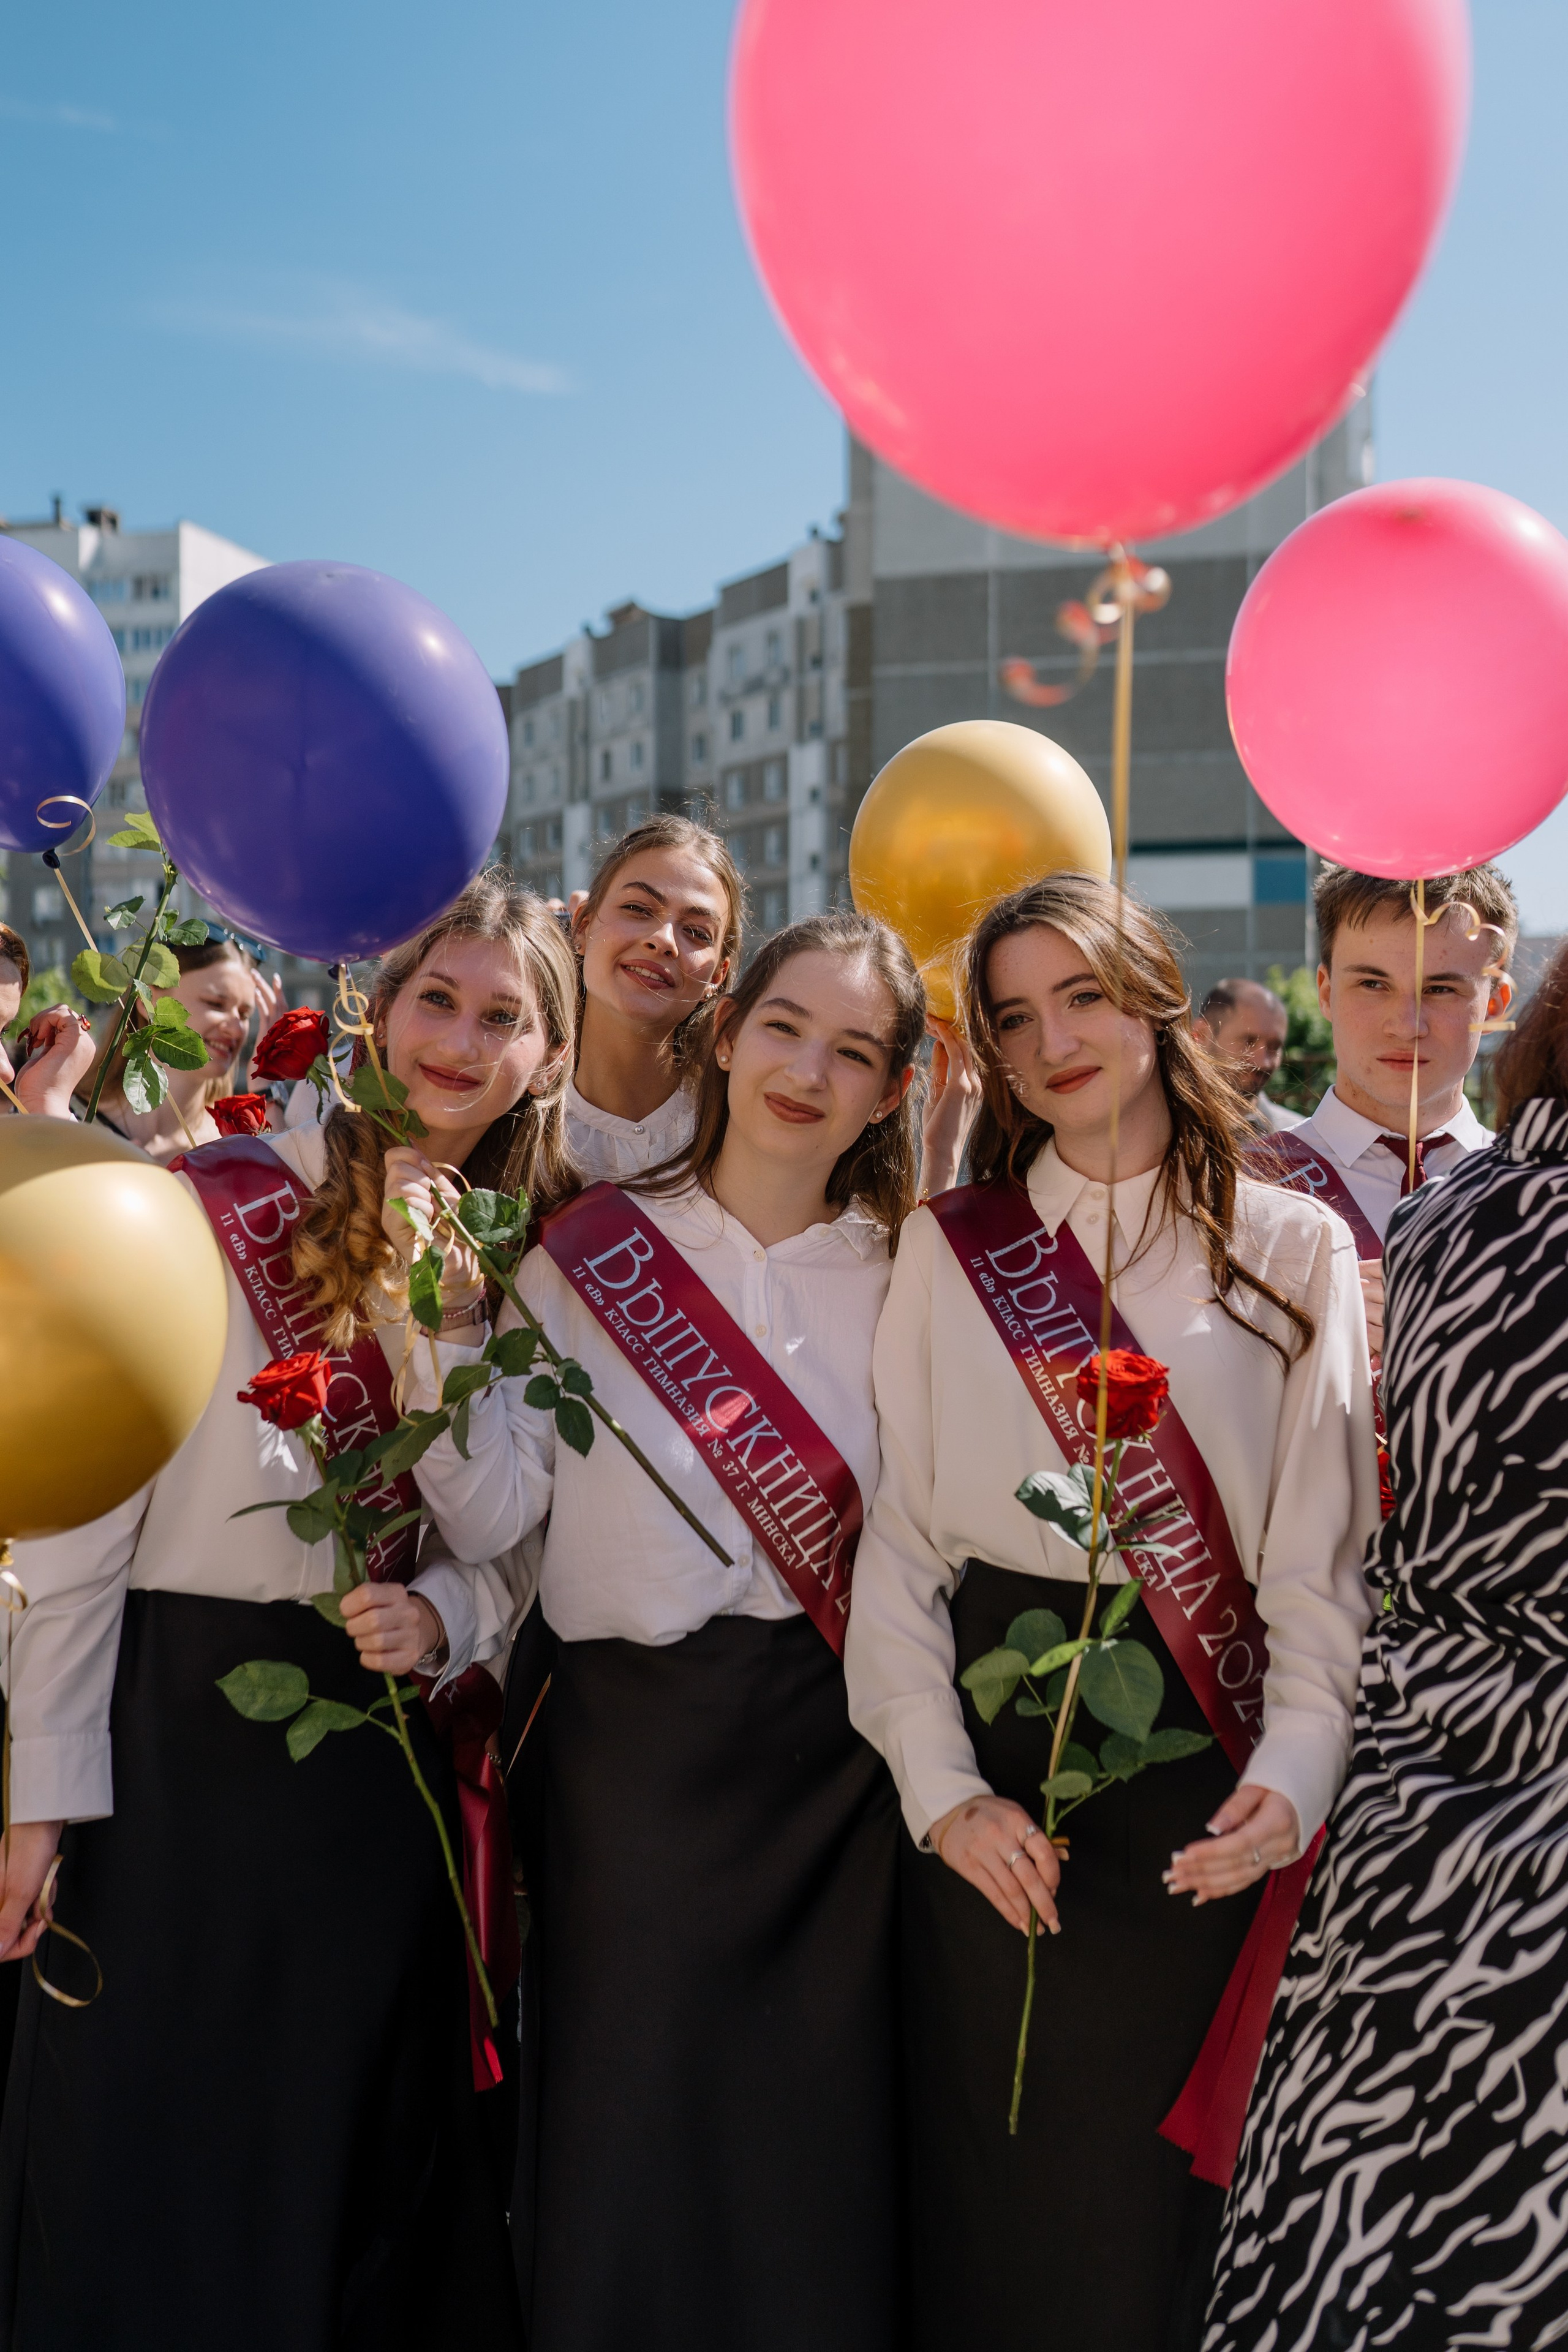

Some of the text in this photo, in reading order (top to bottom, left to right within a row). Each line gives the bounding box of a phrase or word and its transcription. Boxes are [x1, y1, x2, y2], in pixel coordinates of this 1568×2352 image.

[220, 1212, 235, 1227] 11
[229, 1233, 247, 1261] «В»
[244, 1264, 277, 1321] КЛАСС
[970, 1256, 984, 1268] 11
[979, 1272, 996, 1294] «В»
[992, 1295, 1026, 1341] КЛАСС
[1020, 1344, 1079, 1441] ГИМНАЗИЯ
[1072, 1443, 1090, 1464] №
[572, 1265, 796, 1567] 11 «В» КЛАСС ГИМНАЗИЯ № 37 Г. МИНСКА
